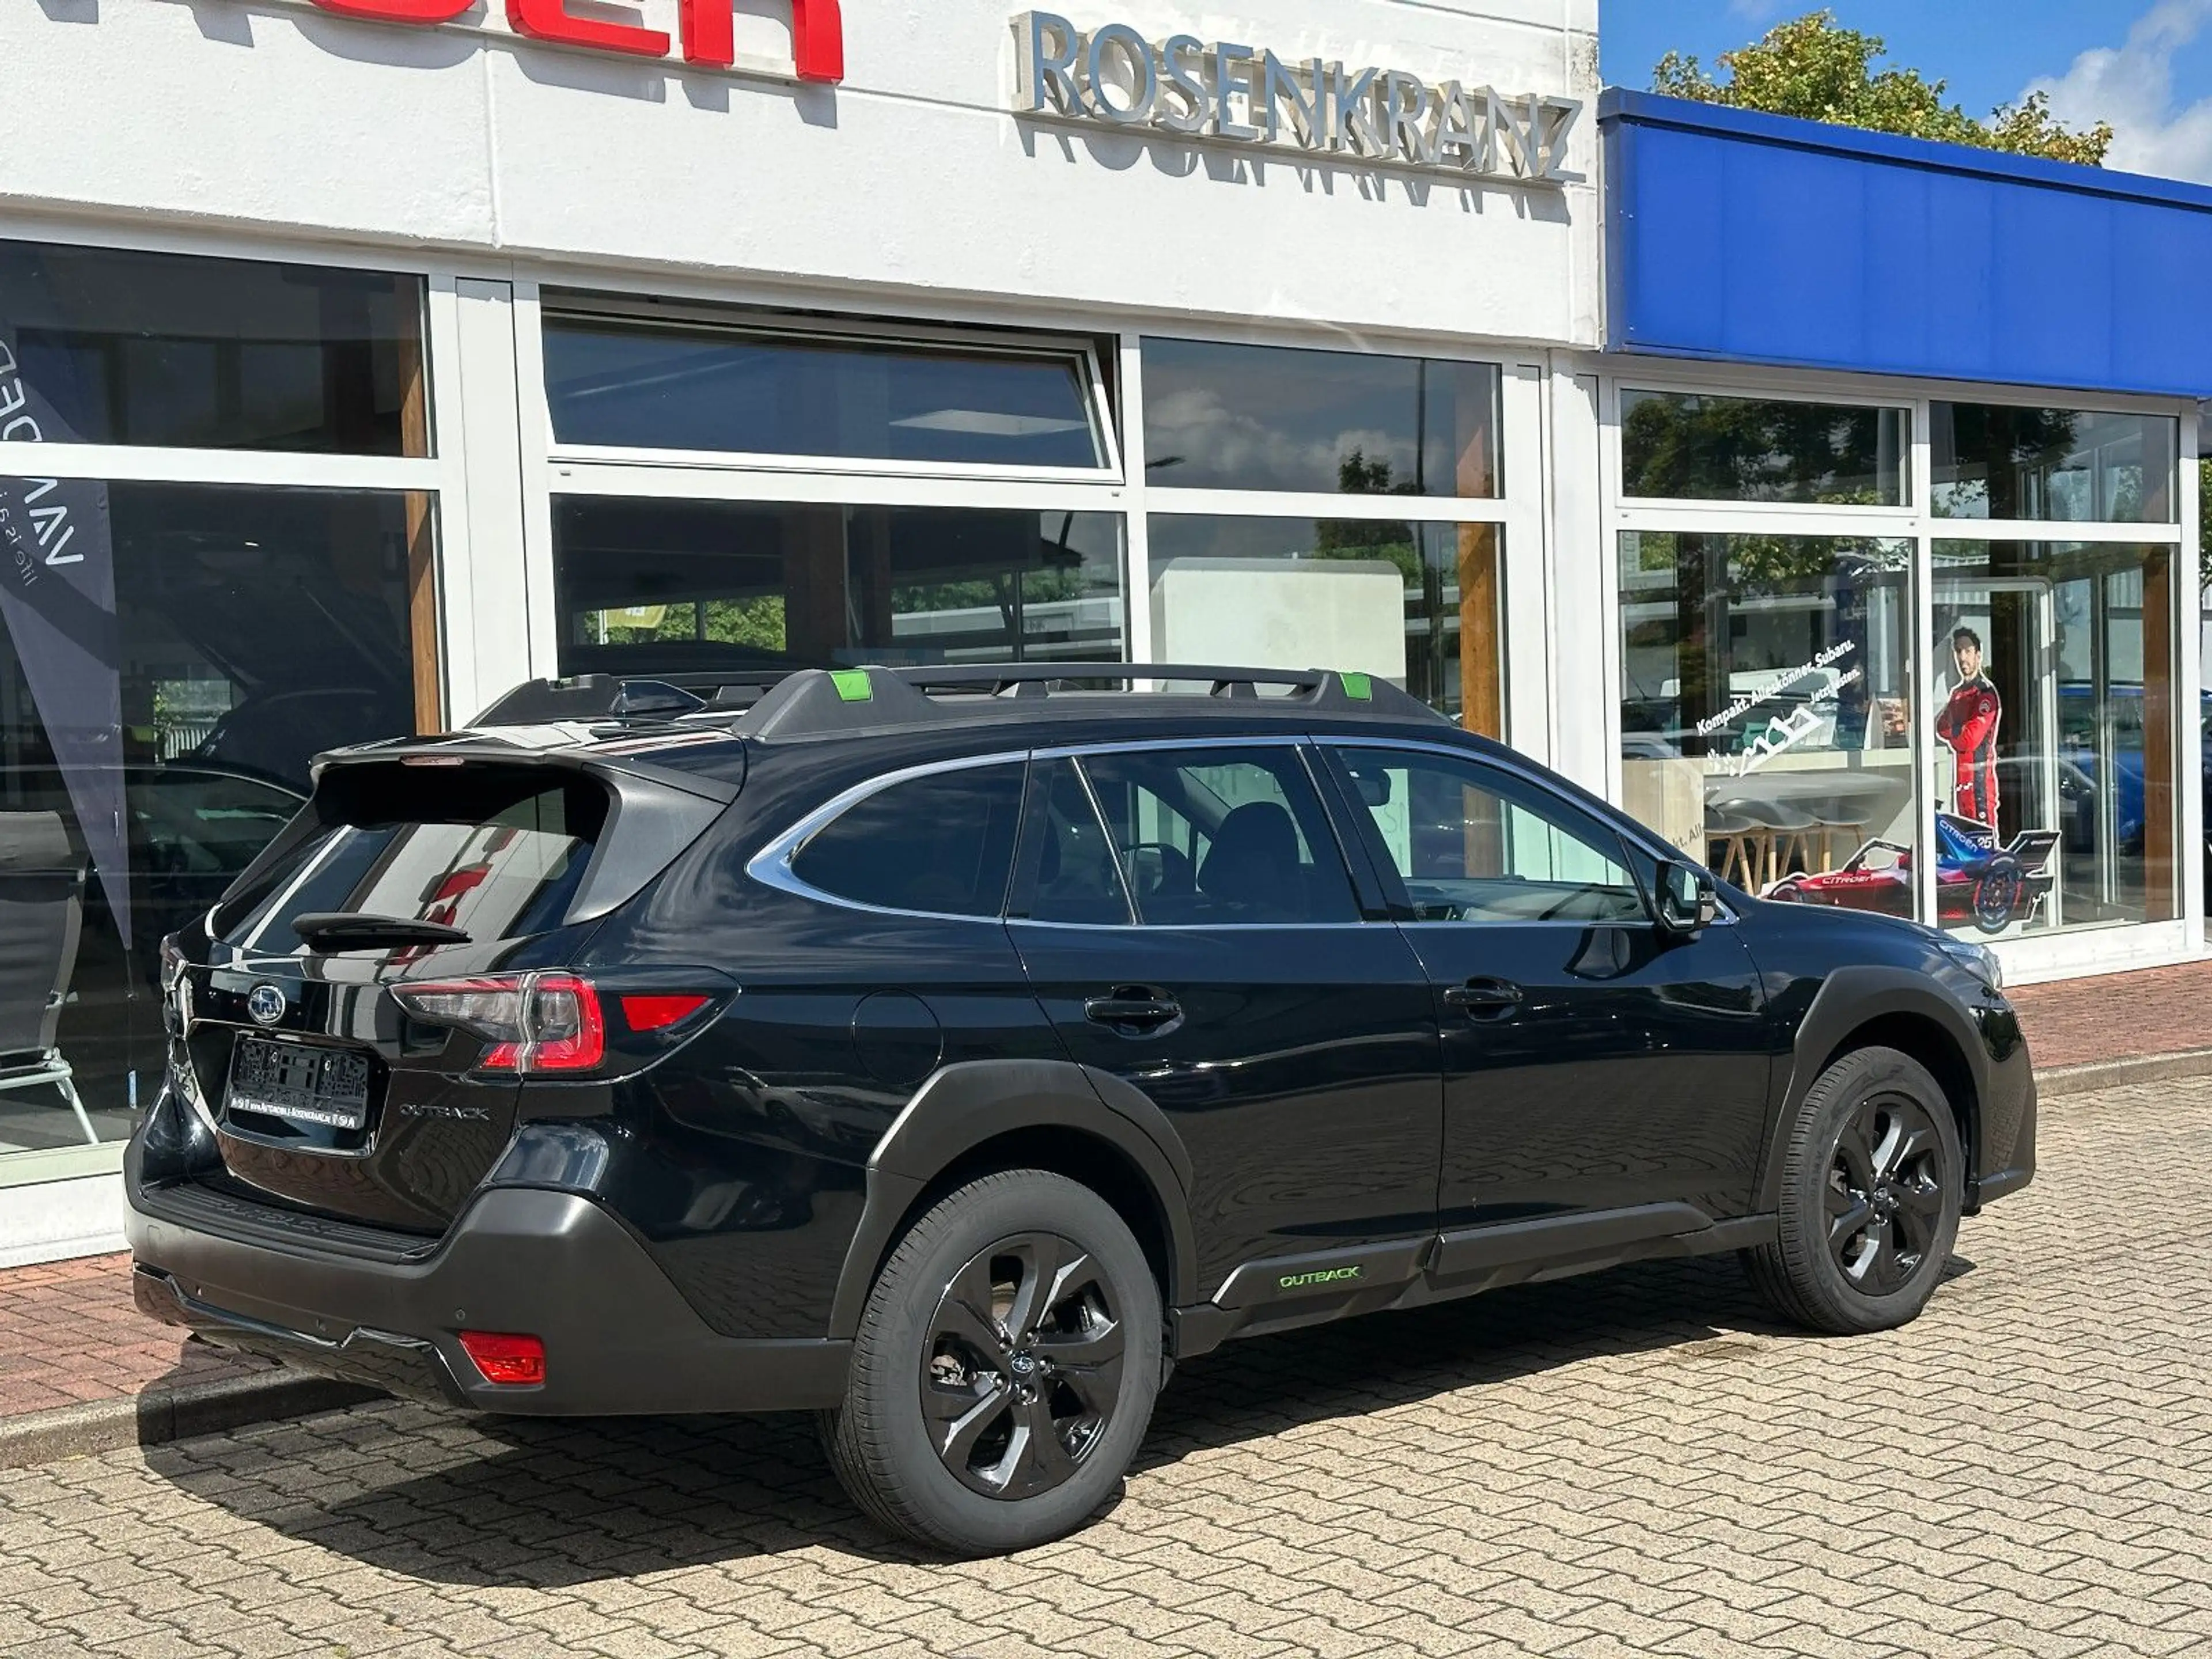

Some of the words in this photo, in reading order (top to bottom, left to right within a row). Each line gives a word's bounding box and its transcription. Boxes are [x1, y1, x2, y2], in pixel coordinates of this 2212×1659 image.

[1016, 10, 1585, 183] ROSENKRANZ
[1696, 698, 1751, 736] Kompakt.
[1815, 639, 1855, 668] Subaru.
[399, 1103, 490, 1121] OUTBACK
[1279, 1266, 1360, 1288] OUTBACK
